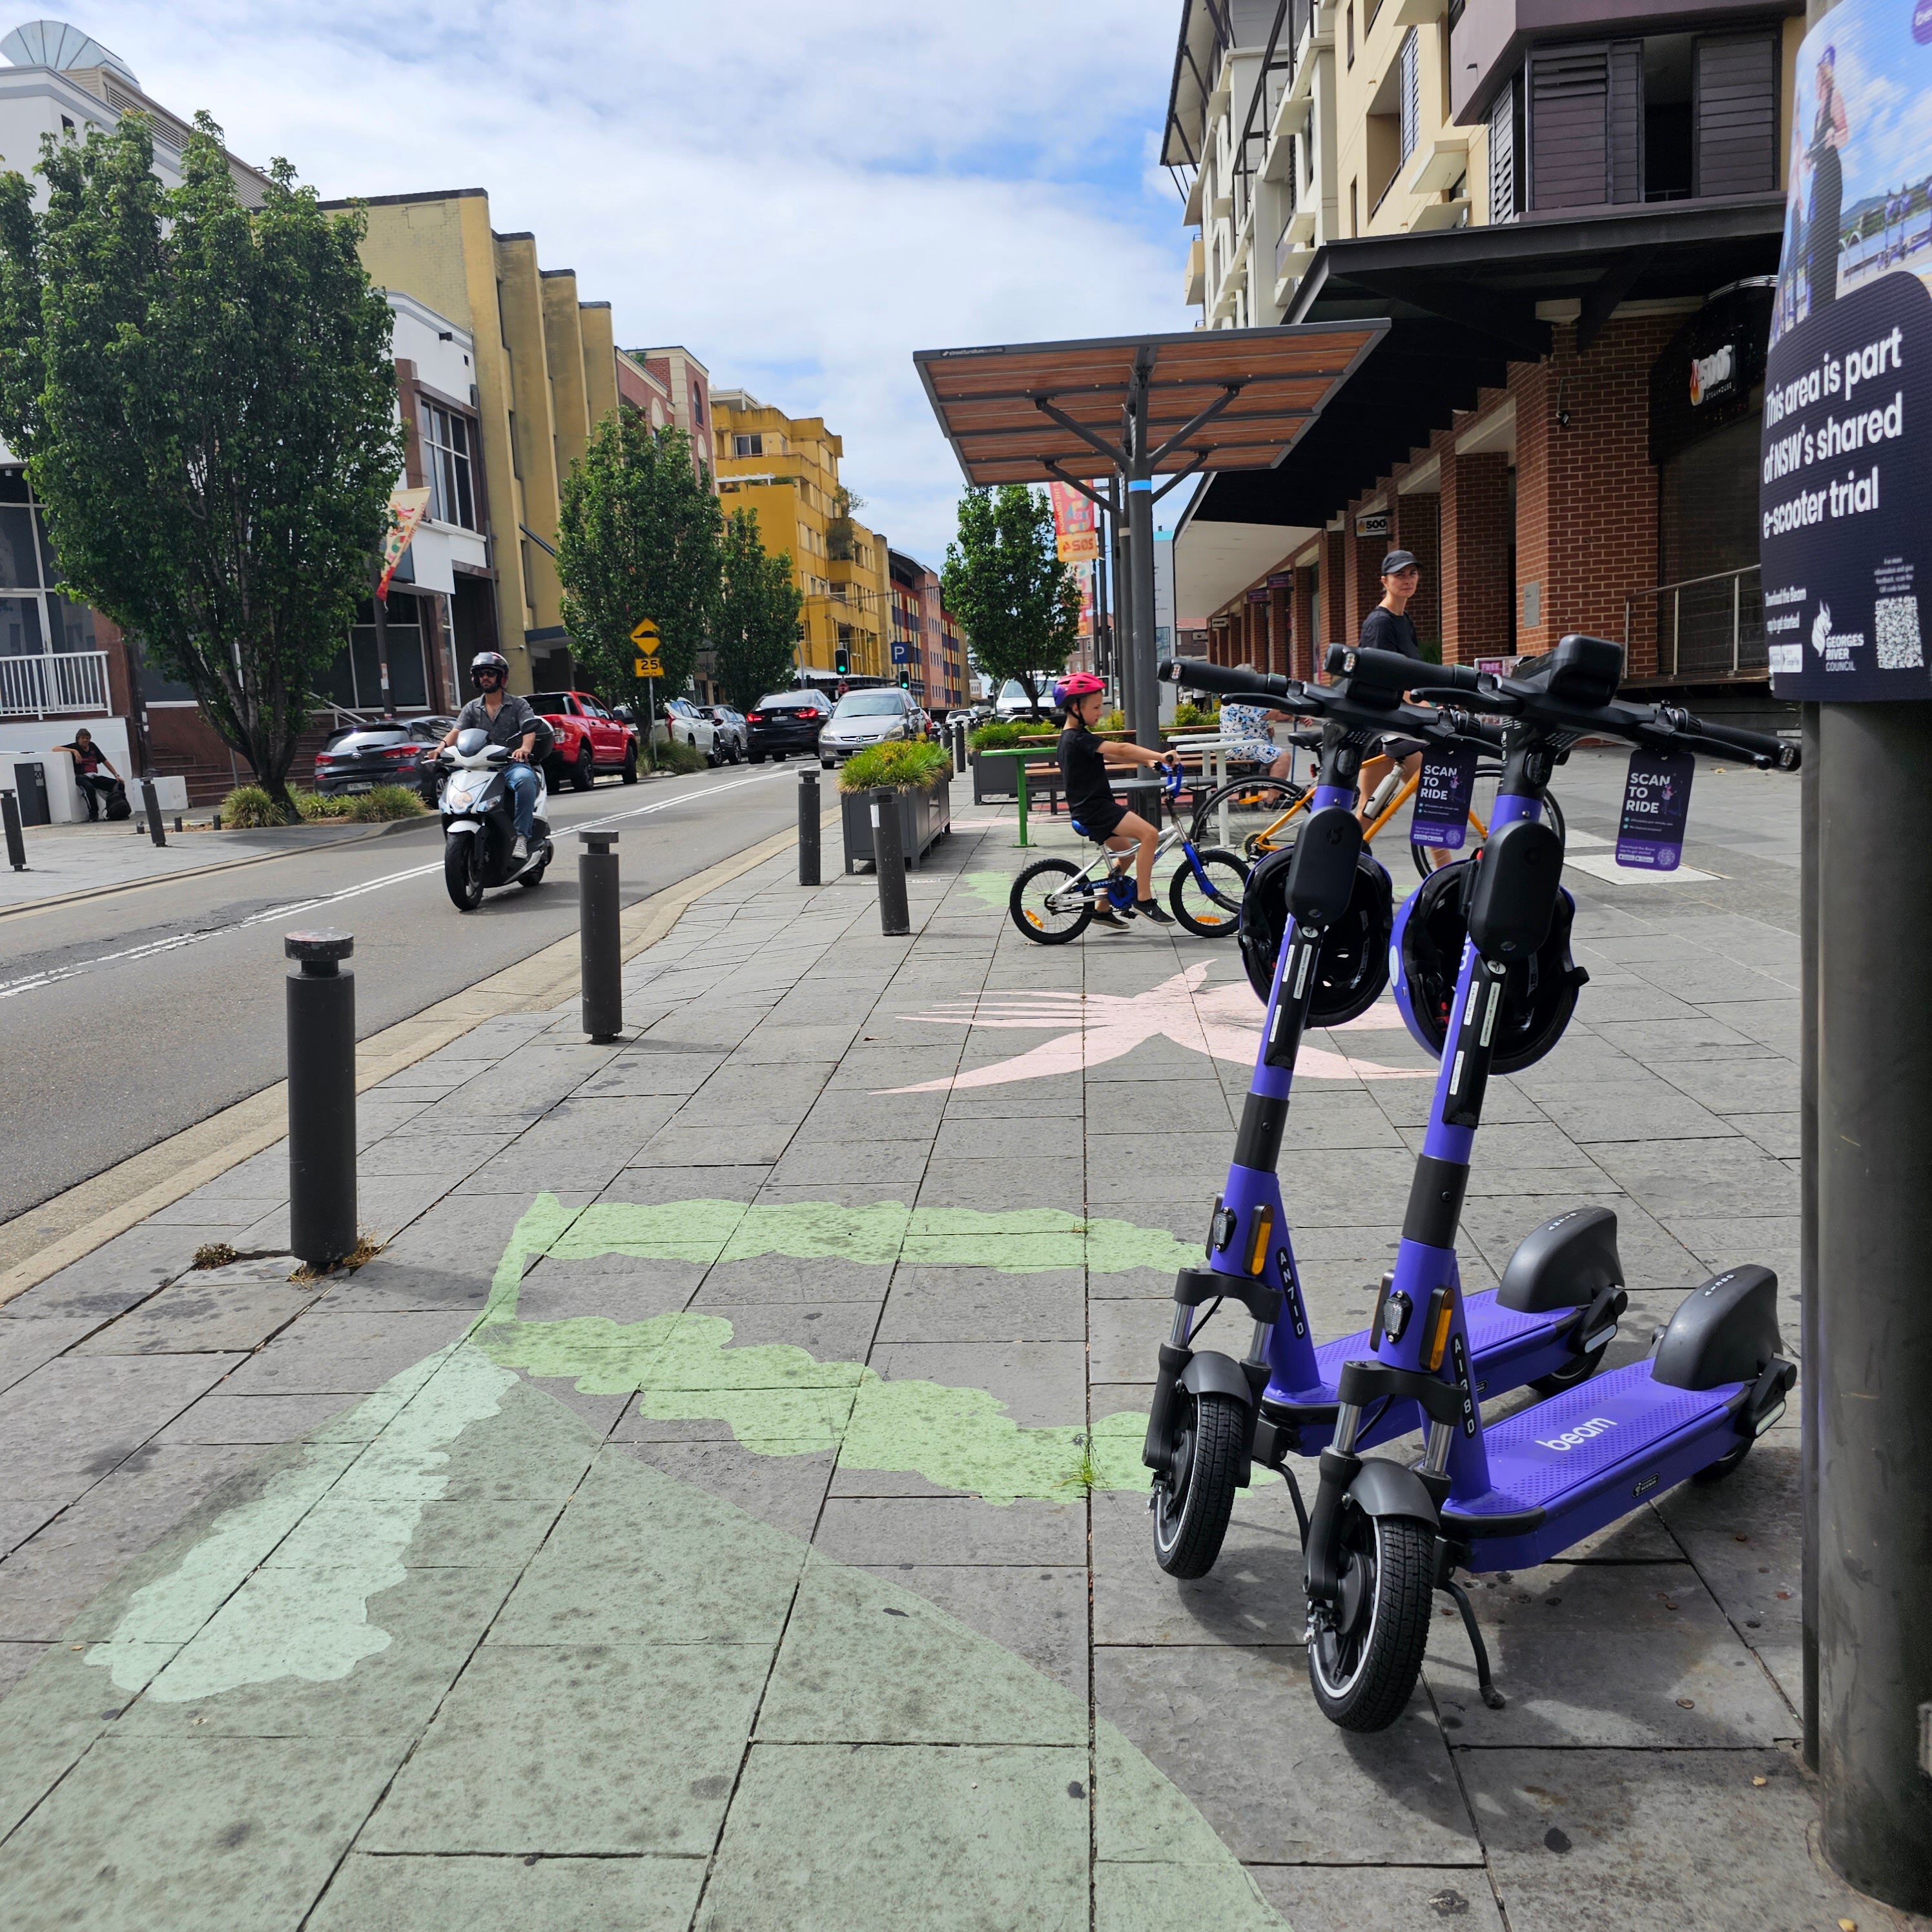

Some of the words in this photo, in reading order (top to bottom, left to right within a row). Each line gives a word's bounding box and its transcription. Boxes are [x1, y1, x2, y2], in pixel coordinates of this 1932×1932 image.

[1766, 382, 1784, 429] This
[1785, 368, 1820, 415] area
[1824, 351, 1840, 396] is
[1845, 327, 1903, 401] part
[1763, 439, 1774, 484] of
[1774, 424, 1813, 480] NSW's
[1816, 391, 1903, 460] shared
[1763, 488, 1827, 539] e-scooter
[1830, 466, 1879, 518] trial
[1826, 633, 1864, 648] GEORGES
[894, 646, 905, 659] P
[1825, 648, 1849, 660] RIVER
[641, 660, 658, 670] 25
[1825, 661, 1856, 672] COUNCIL
[1424, 765, 1457, 777] SCAN
[1423, 777, 1439, 787] TO
[1630, 773, 1670, 786] SCAN
[1421, 788, 1448, 801] RIDE
[1629, 786, 1648, 799] TO
[1626, 800, 1660, 814] RIDE
[1280, 1251, 1304, 1335] AN710
[1535, 1417, 1618, 1452] beam
